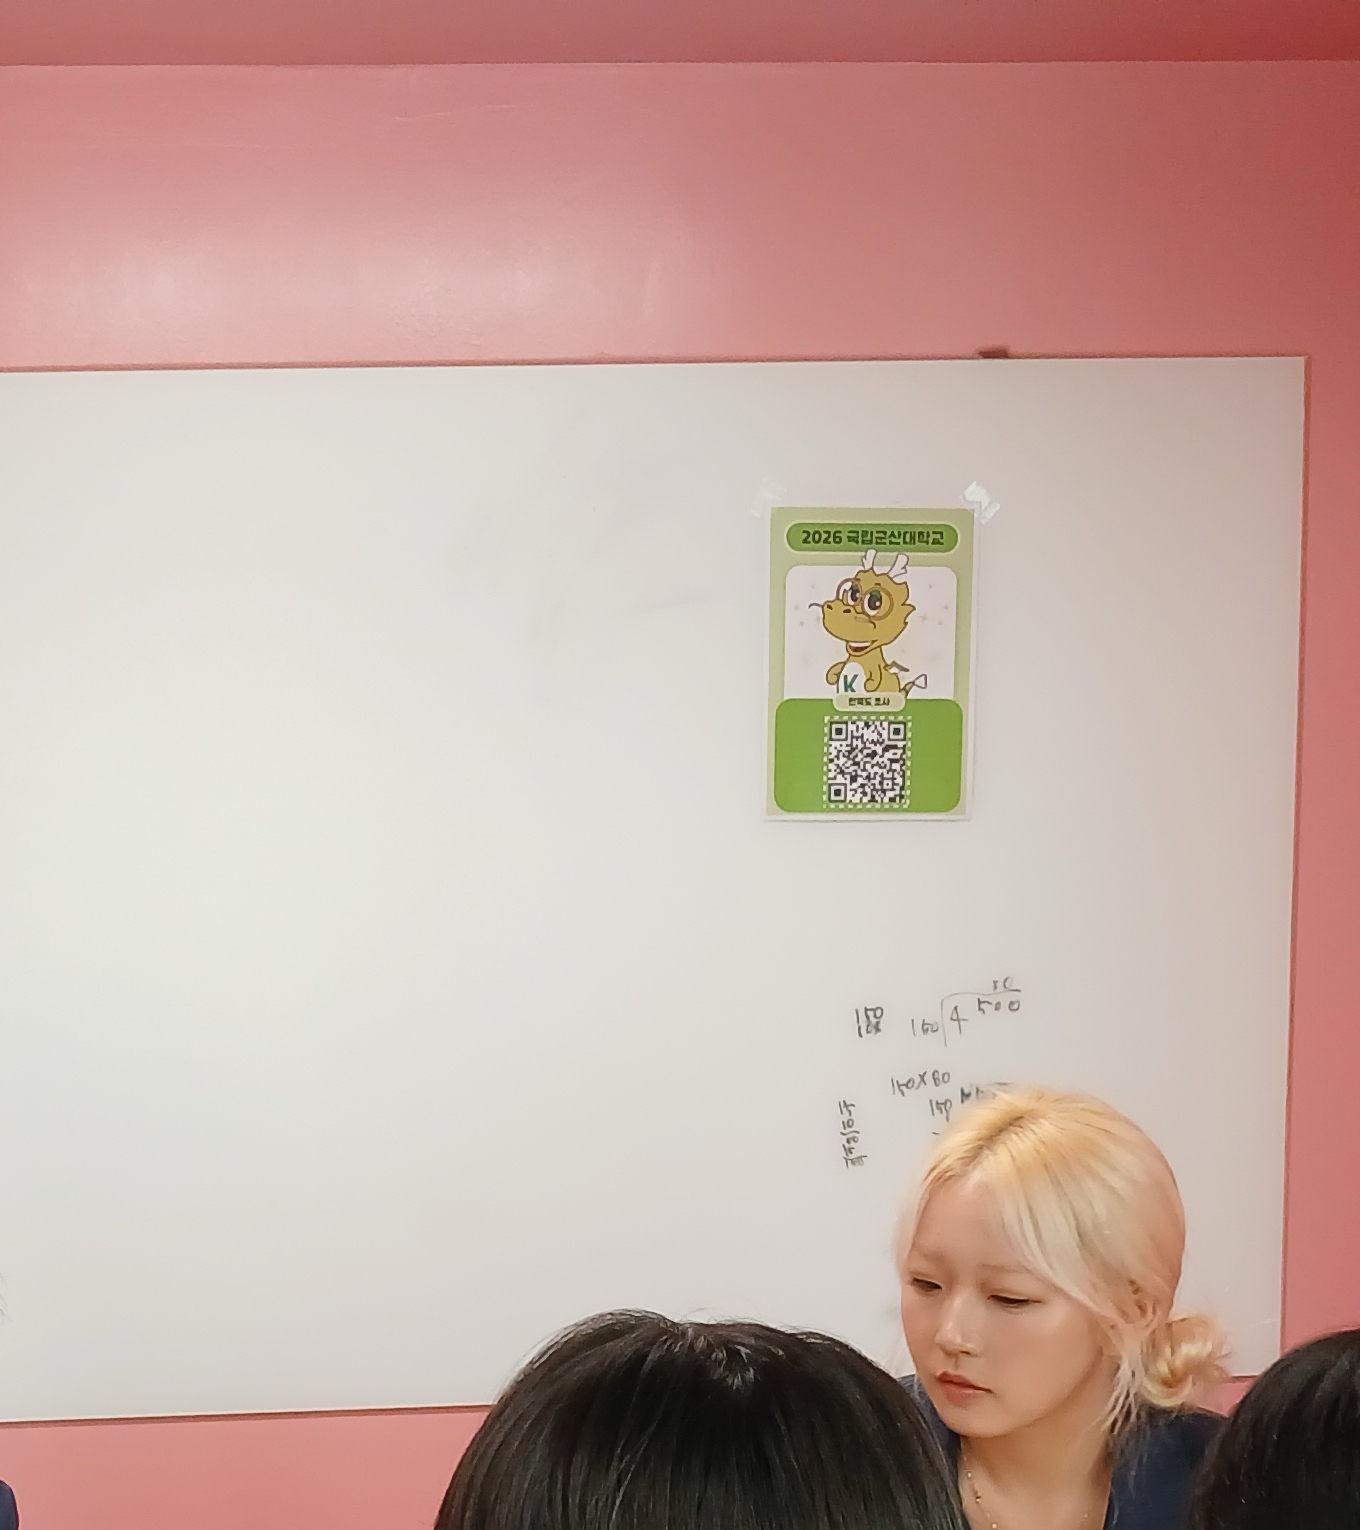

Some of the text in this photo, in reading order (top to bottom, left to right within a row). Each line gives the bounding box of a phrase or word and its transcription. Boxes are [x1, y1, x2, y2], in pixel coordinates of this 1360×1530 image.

[801, 529, 945, 546] 2026 국립군산대학교
[843, 674, 859, 692] K
